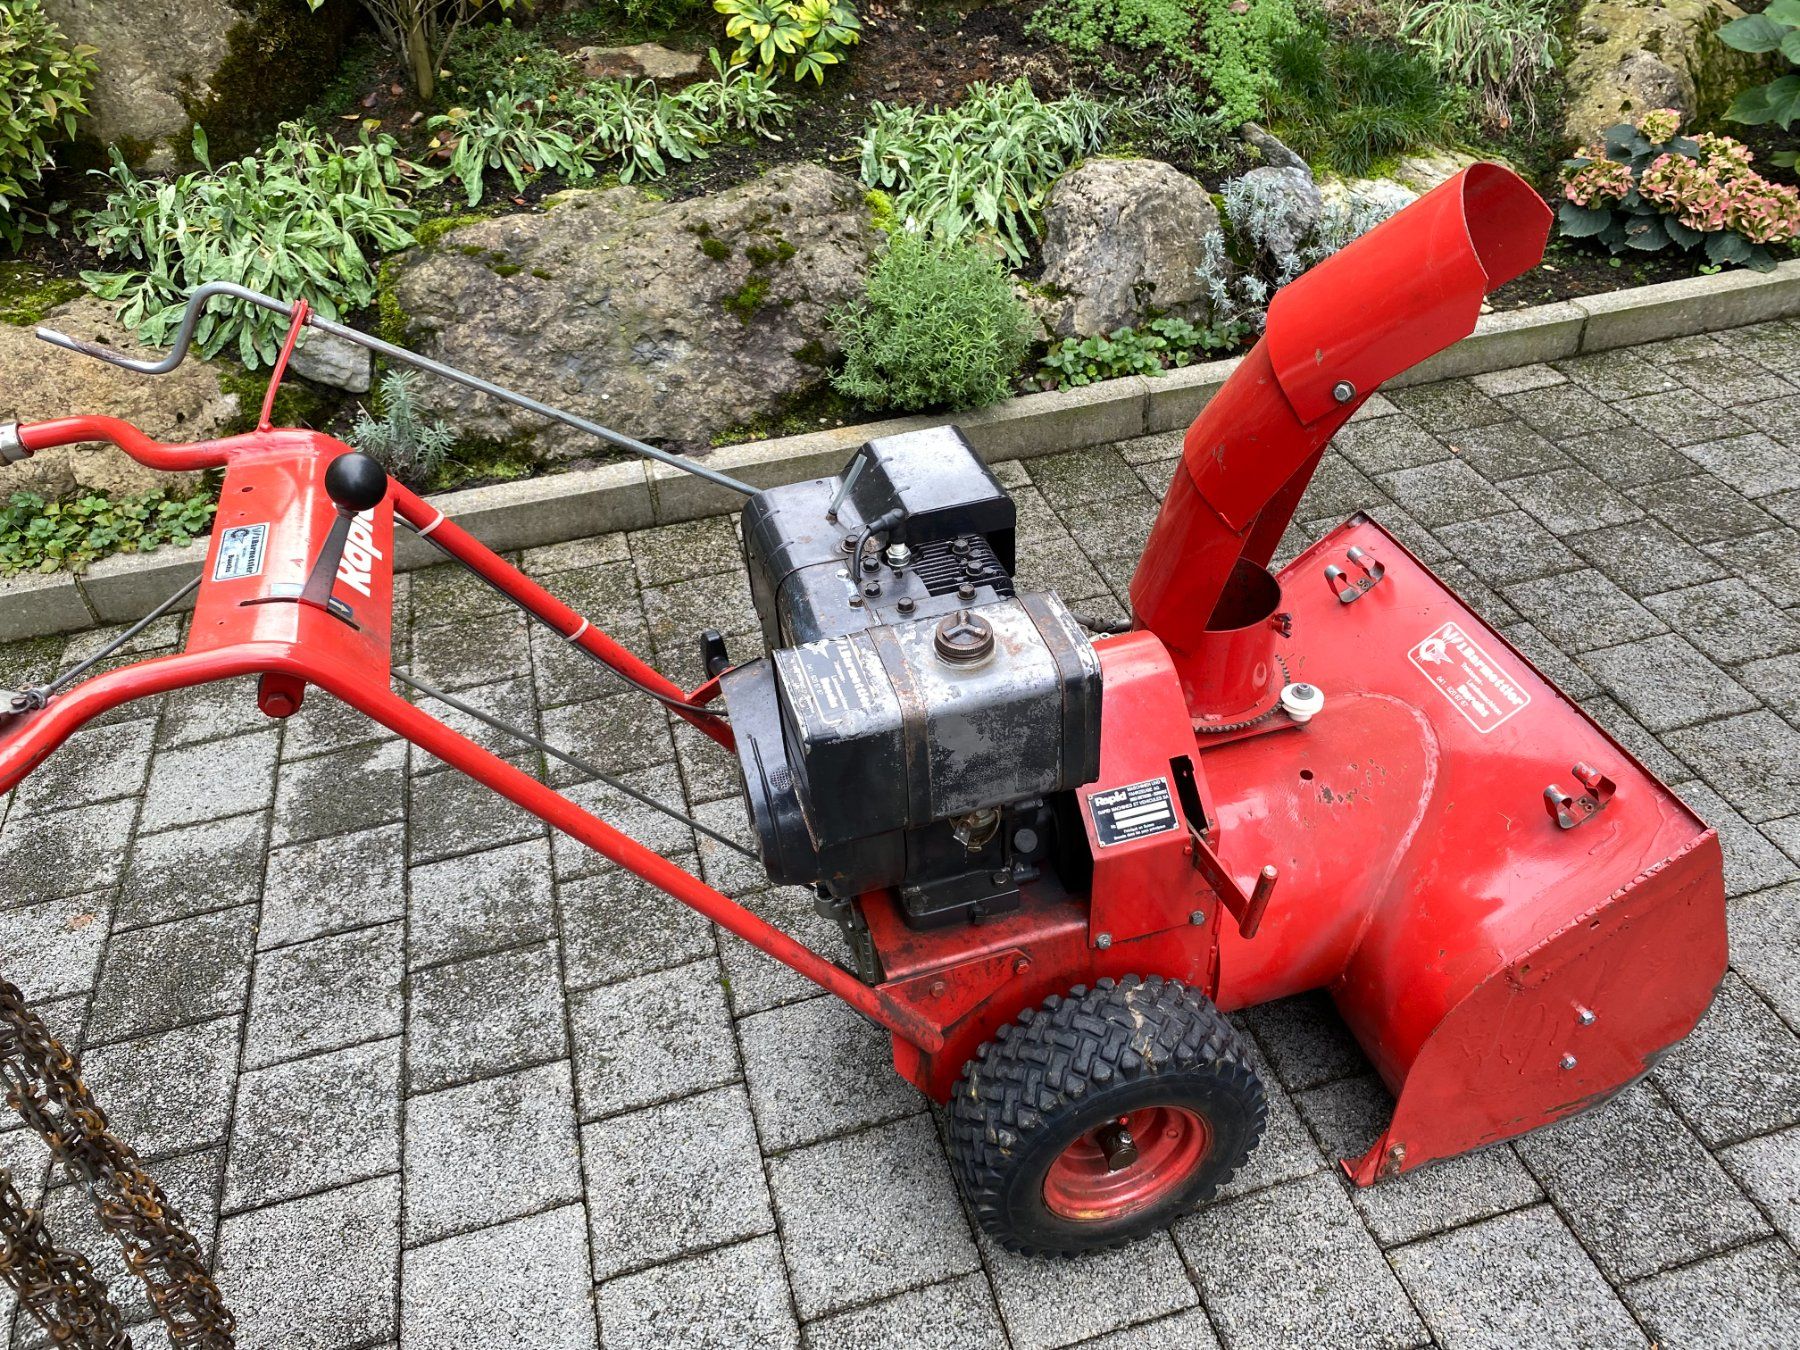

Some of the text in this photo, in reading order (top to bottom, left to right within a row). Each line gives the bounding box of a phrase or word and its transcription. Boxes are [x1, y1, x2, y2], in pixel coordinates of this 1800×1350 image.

[1127, 783, 1151, 791] MASCHINEN
[1094, 790, 1128, 807] Rapid
[1111, 803, 1132, 812] MACHINES
